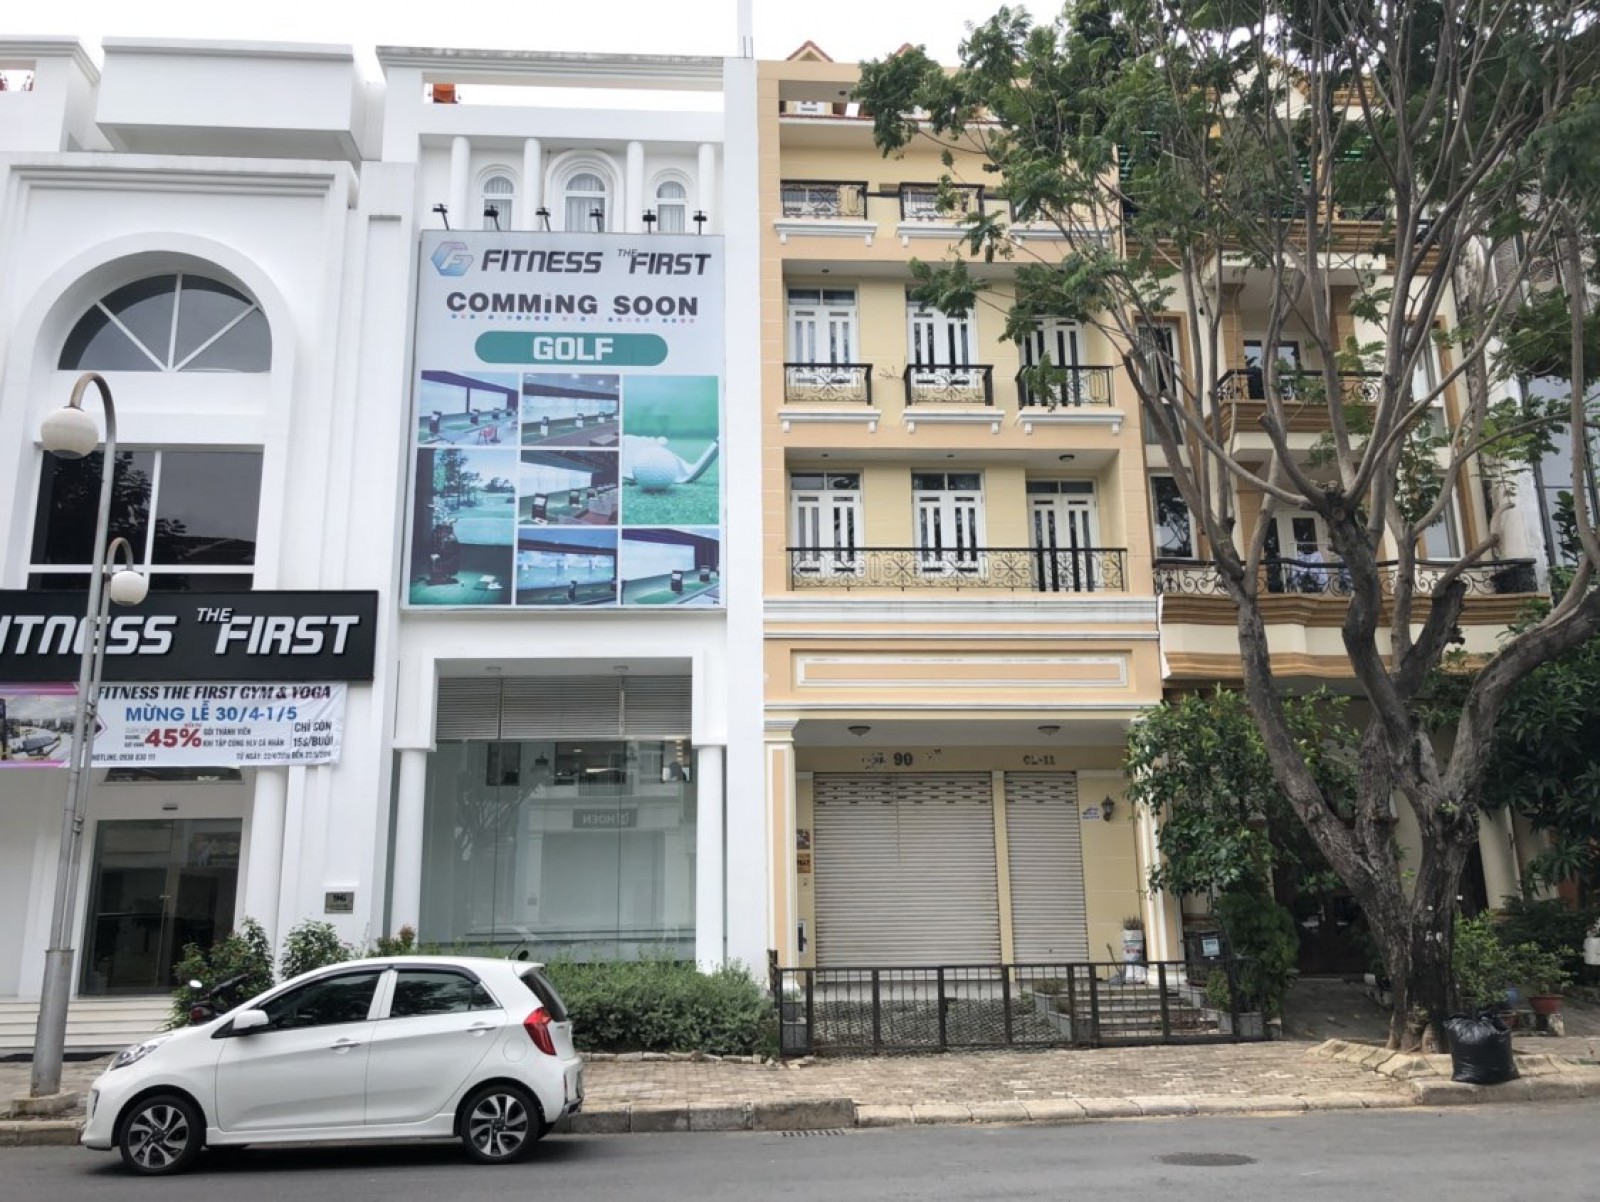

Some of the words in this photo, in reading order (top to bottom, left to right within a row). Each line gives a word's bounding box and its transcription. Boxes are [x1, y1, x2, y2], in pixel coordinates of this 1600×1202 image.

[481, 249, 603, 273] FITNESS
[618, 248, 638, 257] THE
[629, 252, 712, 275] FIRST
[613, 295, 698, 316] SOON
[533, 337, 614, 361] GOLF
[197, 607, 233, 622] THE
[215, 615, 360, 655] FIRST
[98, 686, 160, 700] FITNESS
[163, 686, 193, 700] THE
[194, 686, 238, 700] FIRST
[240, 686, 274, 700] GYM
[275, 686, 287, 699] &
[292, 685, 331, 699] YOGA
[125, 703, 186, 721] MỪNG
[191, 700, 210, 721] LỄ
[216, 706, 298, 722] 30/4-1/5
[144, 728, 203, 748] 45%
[893, 751, 914, 767] 90
